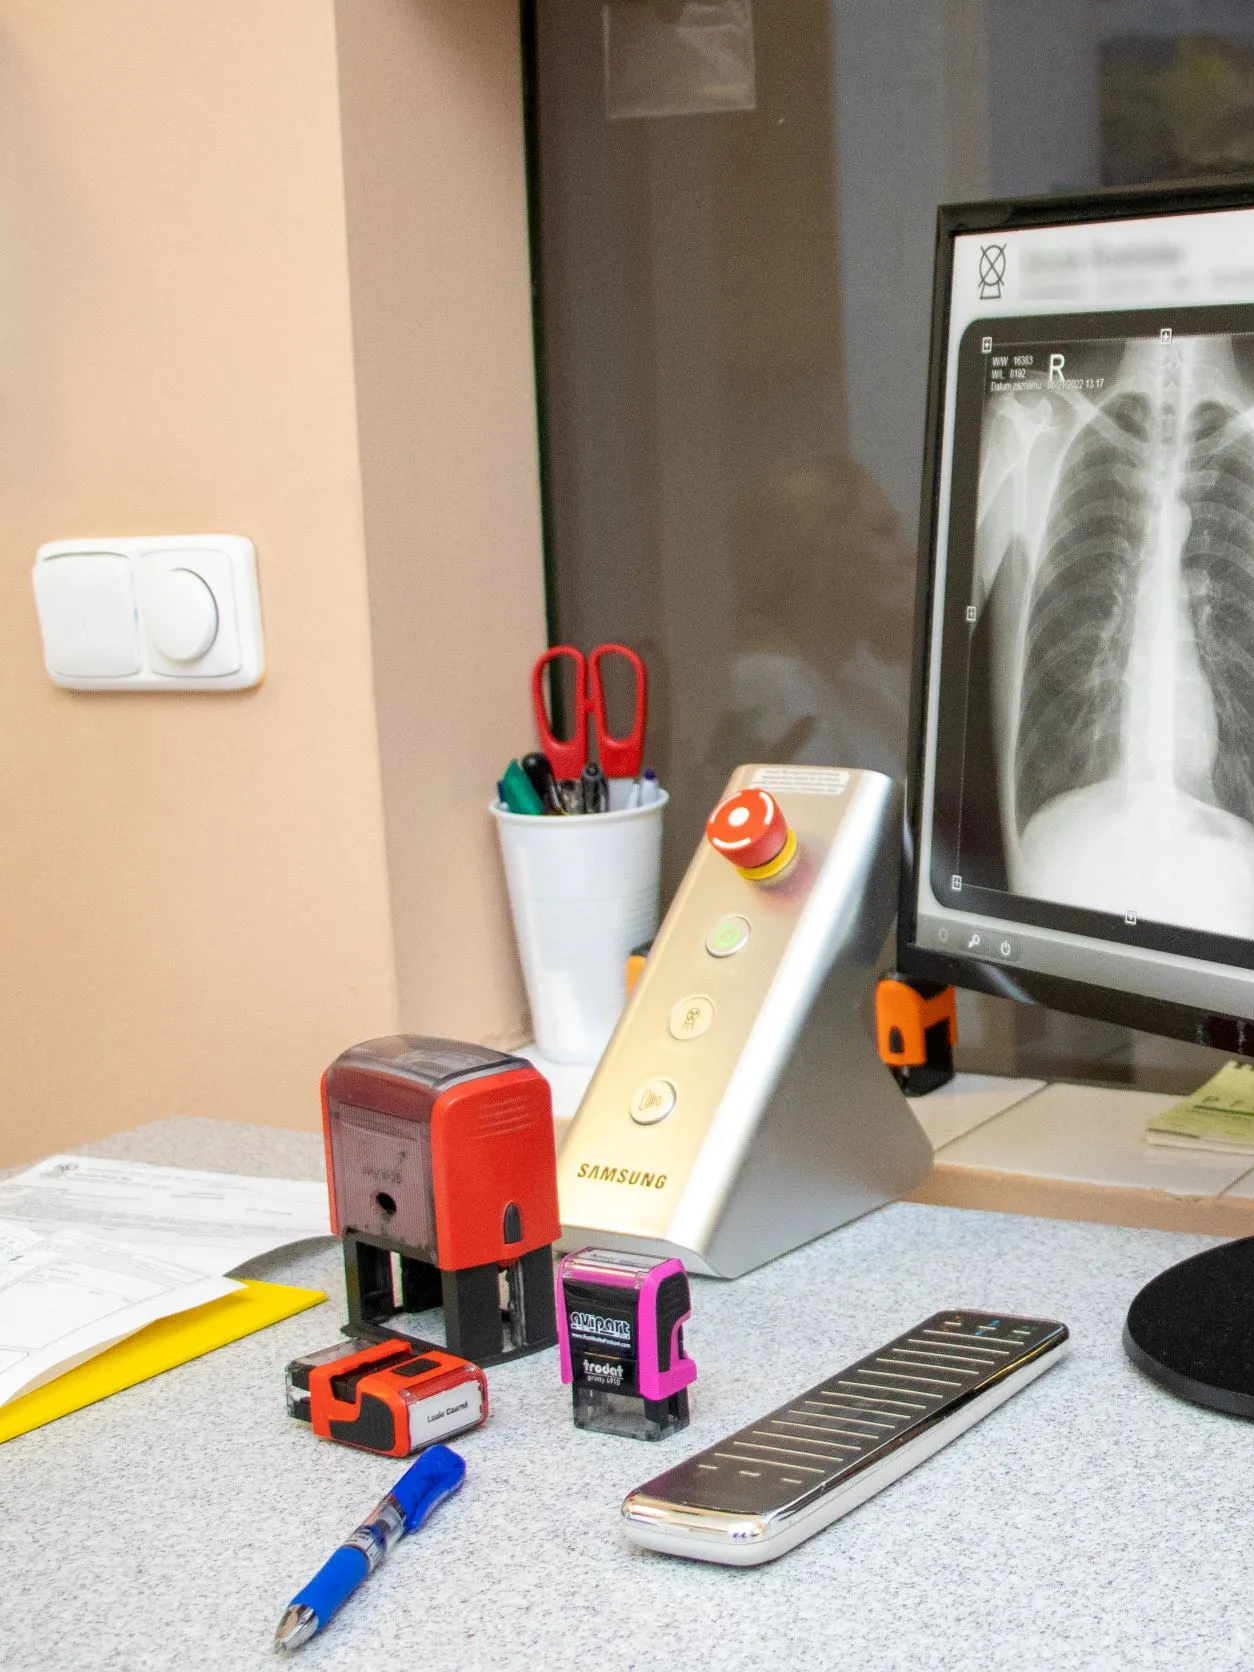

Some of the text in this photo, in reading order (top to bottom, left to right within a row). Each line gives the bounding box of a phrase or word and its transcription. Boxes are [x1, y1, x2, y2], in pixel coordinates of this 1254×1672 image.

[1049, 353, 1066, 383] R
[577, 1163, 668, 1190] SAMSUNG
[582, 1358, 624, 1377] trodat
